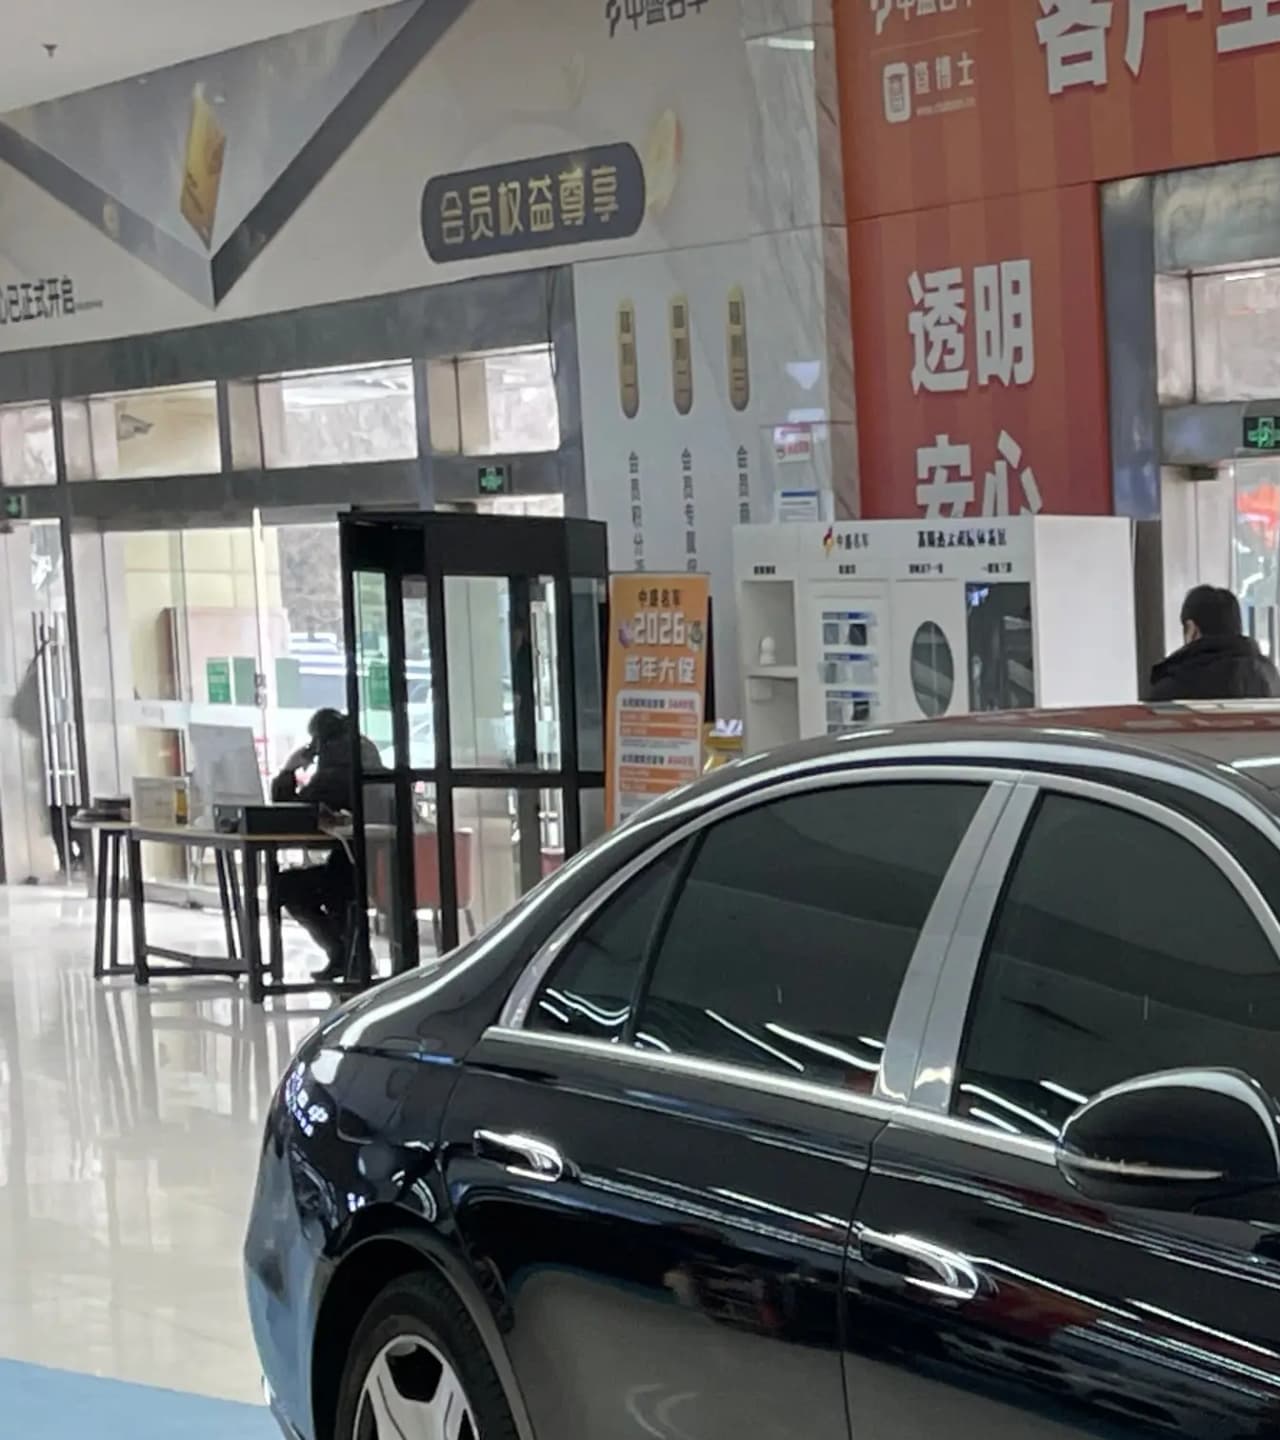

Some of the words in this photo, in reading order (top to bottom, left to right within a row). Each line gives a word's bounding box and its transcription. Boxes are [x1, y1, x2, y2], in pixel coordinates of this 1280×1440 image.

[440, 165, 619, 245] 会员权益尊享
[908, 259, 1034, 395] 透明
[916, 430, 1043, 518] 安心
[633, 611, 685, 645] 2026
